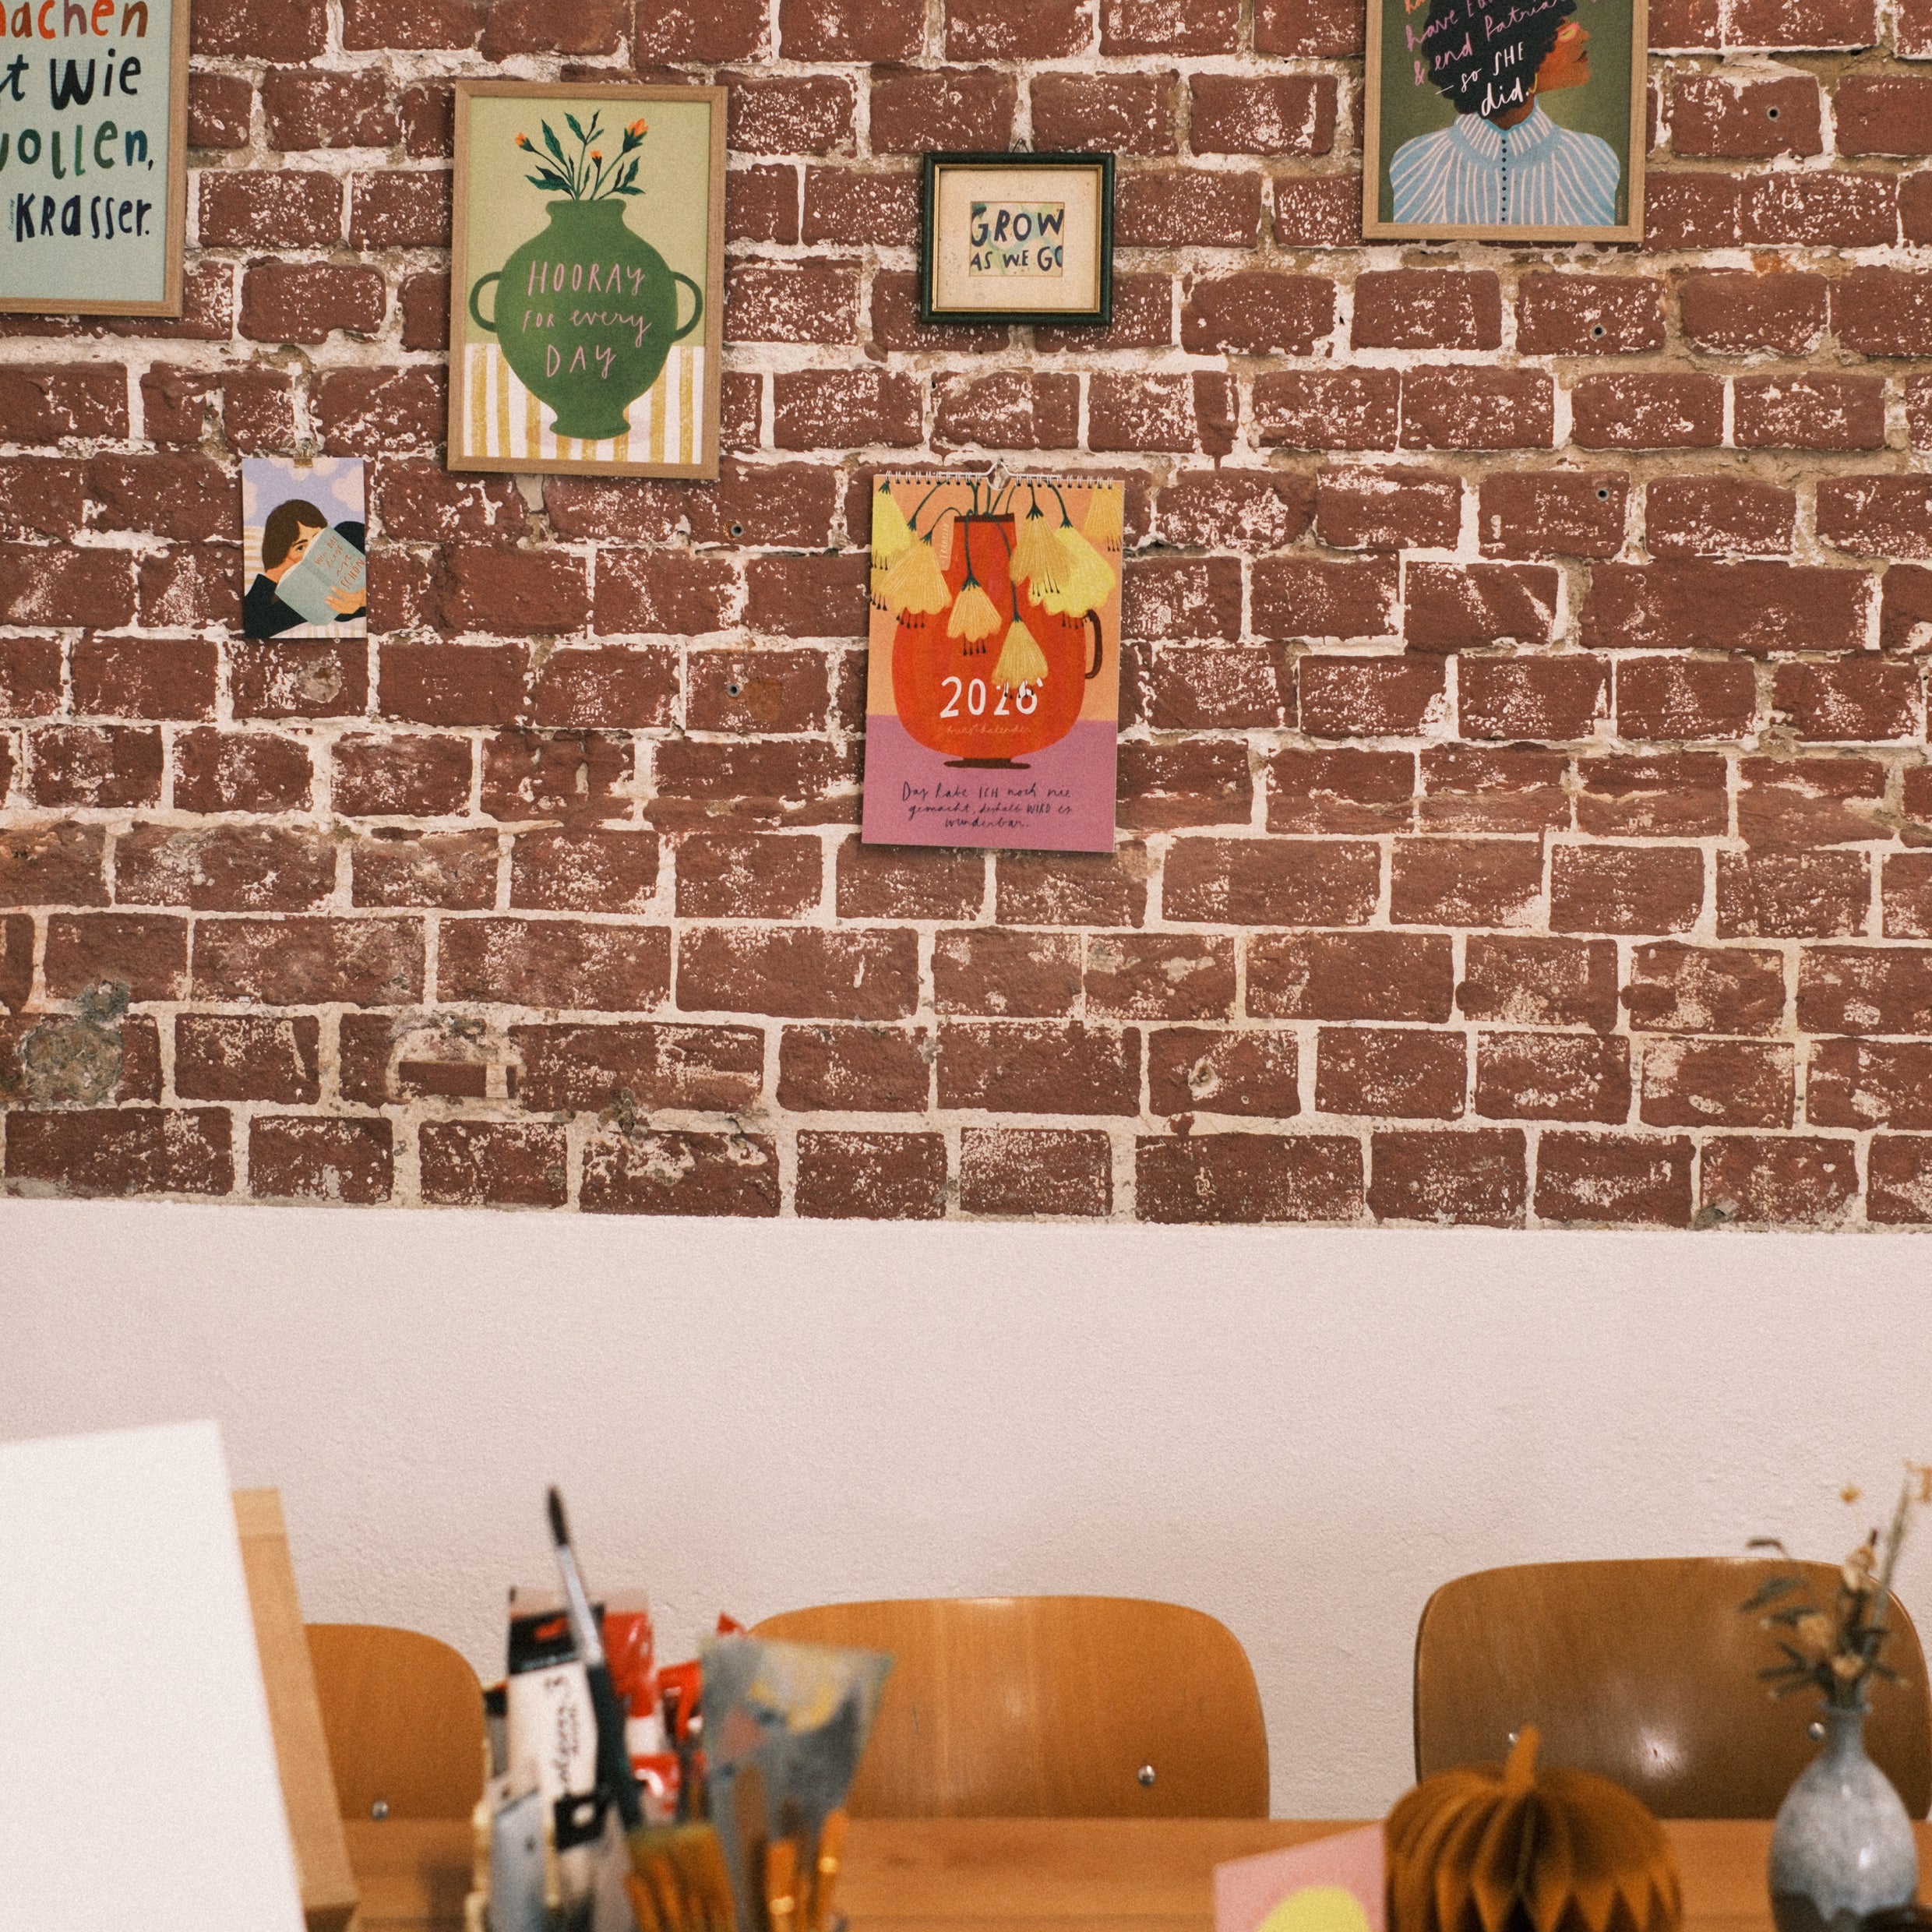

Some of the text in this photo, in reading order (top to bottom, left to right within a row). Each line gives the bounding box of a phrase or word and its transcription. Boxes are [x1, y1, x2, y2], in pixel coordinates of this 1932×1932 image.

[0, 0, 148, 39] achen
[1405, 9, 1458, 52] have
[1434, 32, 1472, 72] end
[1461, 68, 1482, 93] so
[1493, 41, 1524, 76] SHE
[1481, 76, 1529, 117] did.
[971, 206, 1064, 247] GROW
[970, 251, 992, 271] AS
[1002, 250, 1029, 268] WE
[569, 309, 653, 348] every
[940, 676, 1044, 718] 2026
[903, 781, 928, 801] Das
[936, 782, 968, 799] habe
[1007, 782, 1036, 797] noch
[1047, 784, 1070, 798] nie
[1058, 806, 1072, 814] es
